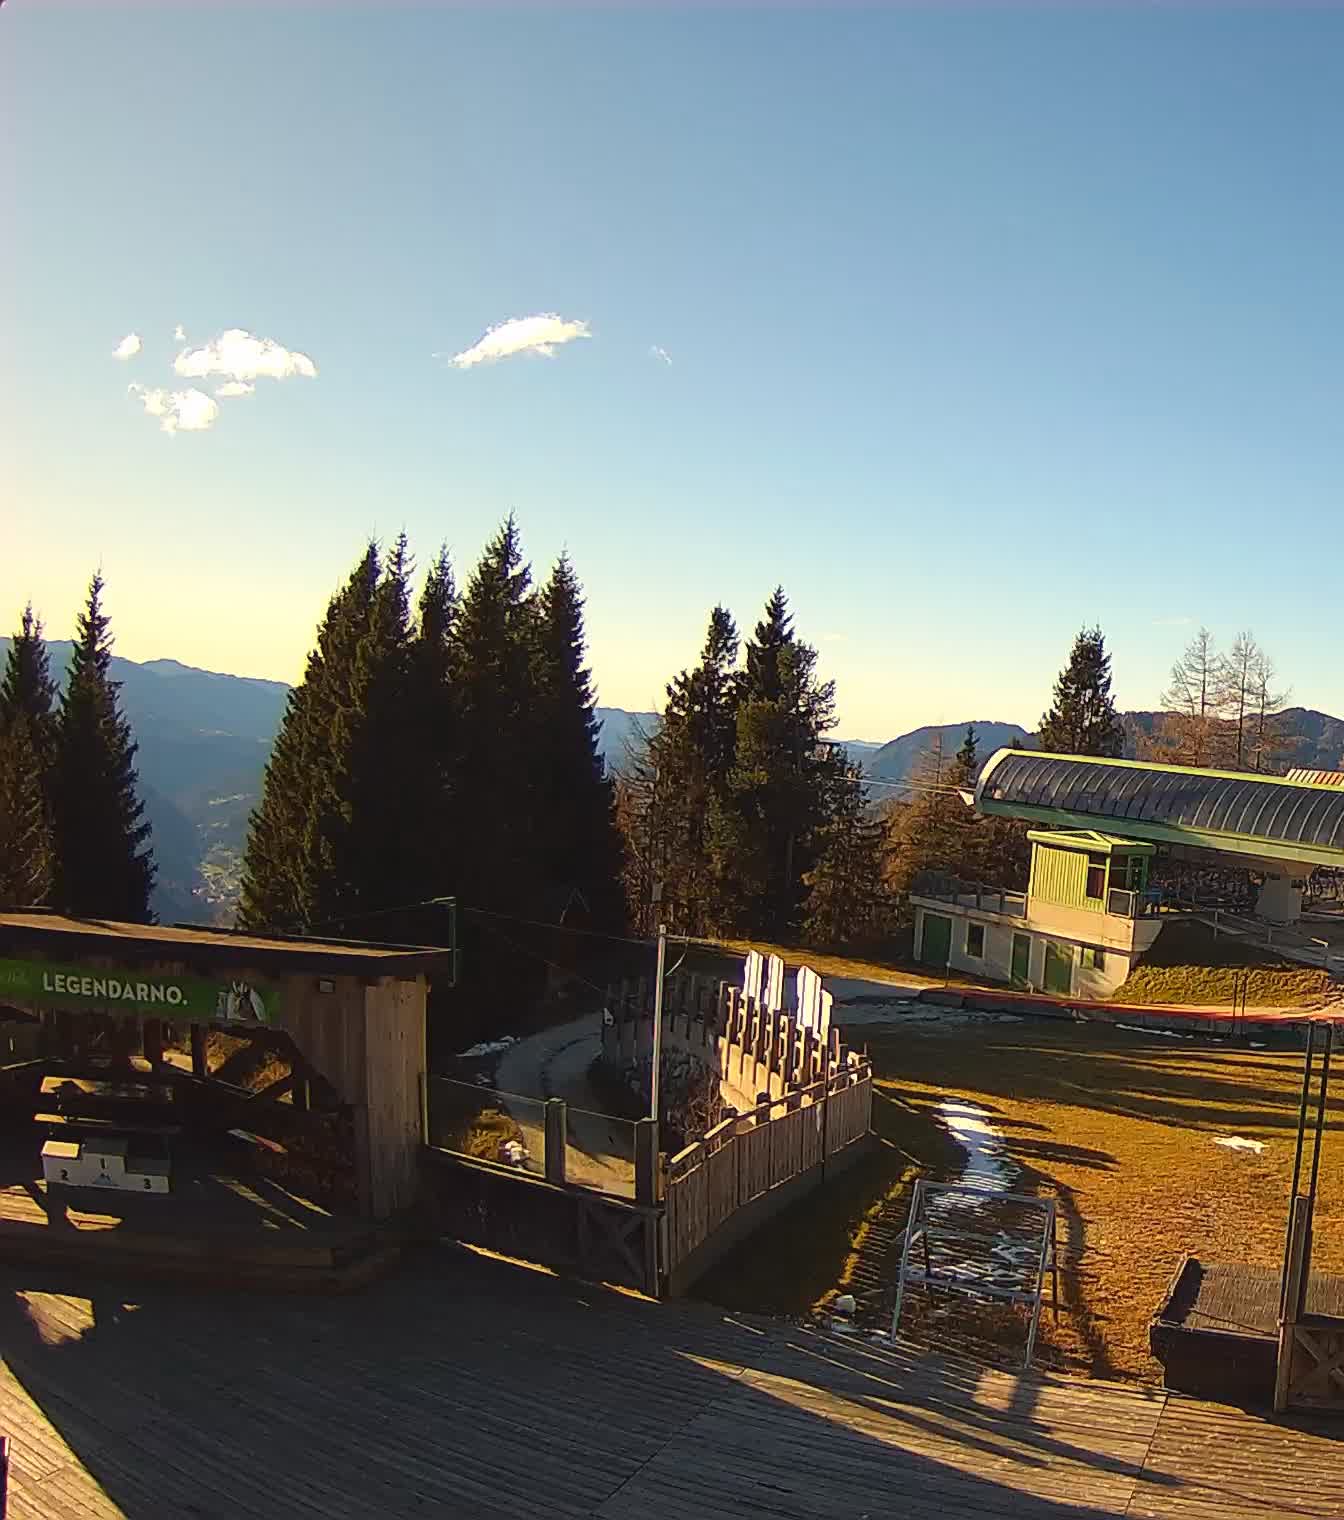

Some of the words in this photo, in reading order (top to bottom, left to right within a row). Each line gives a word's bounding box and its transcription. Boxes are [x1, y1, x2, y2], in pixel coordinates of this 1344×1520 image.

[42, 972, 189, 1006] LEGENDARNO.
[100, 1158, 106, 1169] 1
[60, 1169, 69, 1181] 2
[143, 1178, 152, 1189] 3
